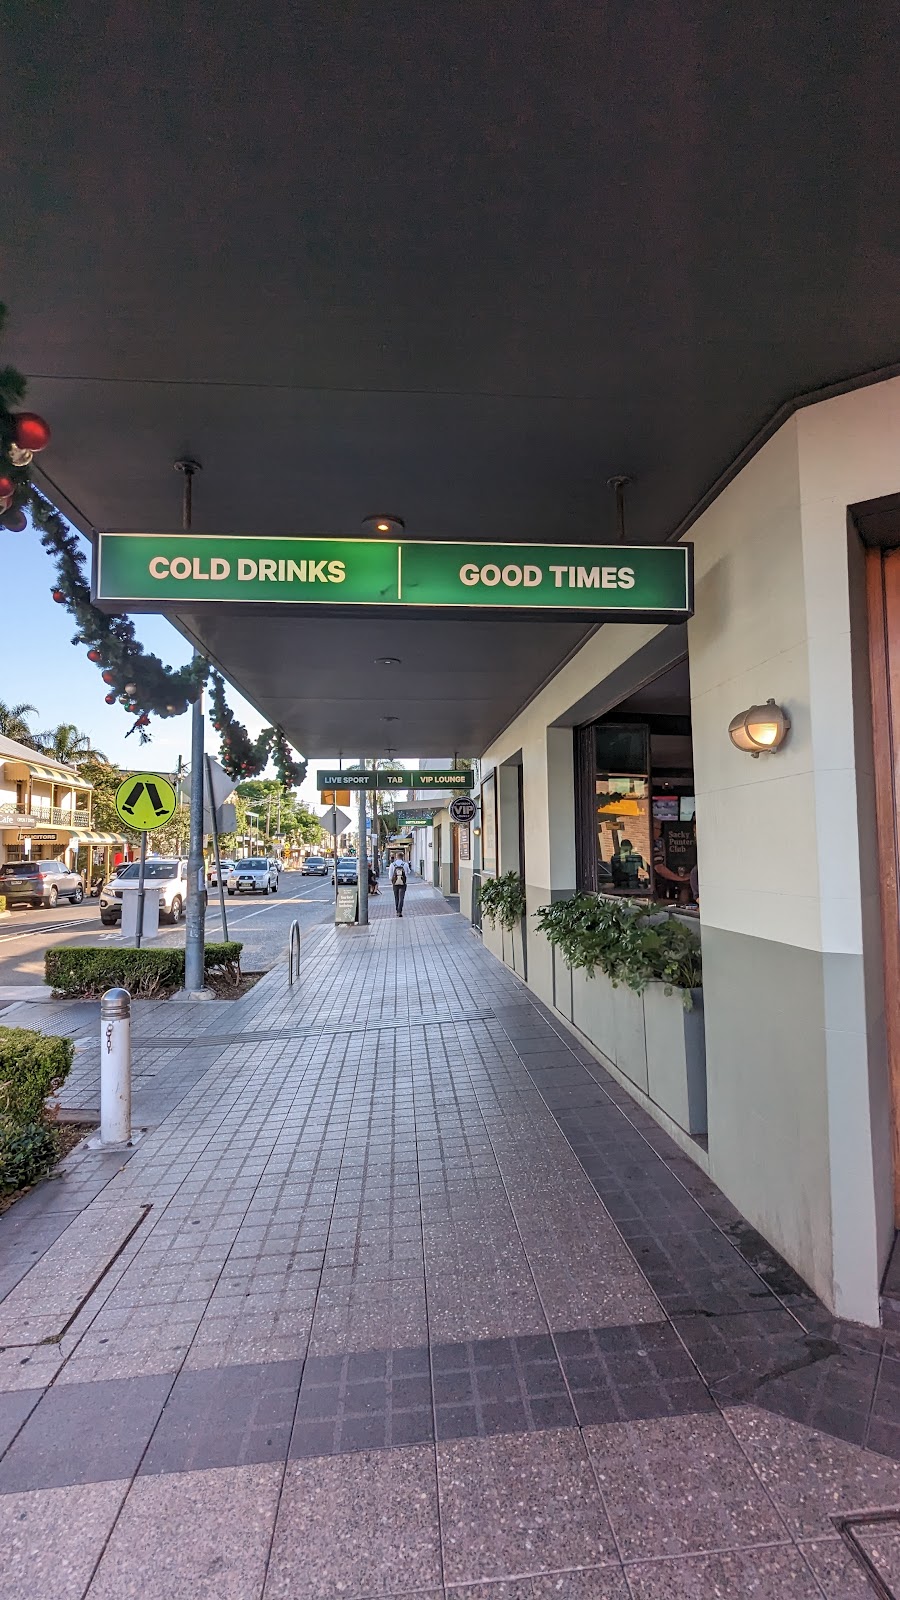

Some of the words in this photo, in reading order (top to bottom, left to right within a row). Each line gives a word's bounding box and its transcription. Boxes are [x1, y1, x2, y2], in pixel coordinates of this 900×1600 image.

[149, 556, 231, 580] COLD
[237, 558, 346, 583] DRINKS
[459, 563, 543, 587] GOOD
[549, 565, 636, 589] TIMES
[324, 776, 342, 784] LIVE
[343, 776, 369, 784] SPORT
[387, 776, 403, 784] TAB
[453, 805, 474, 815] VIP
[669, 845, 686, 853] Club
